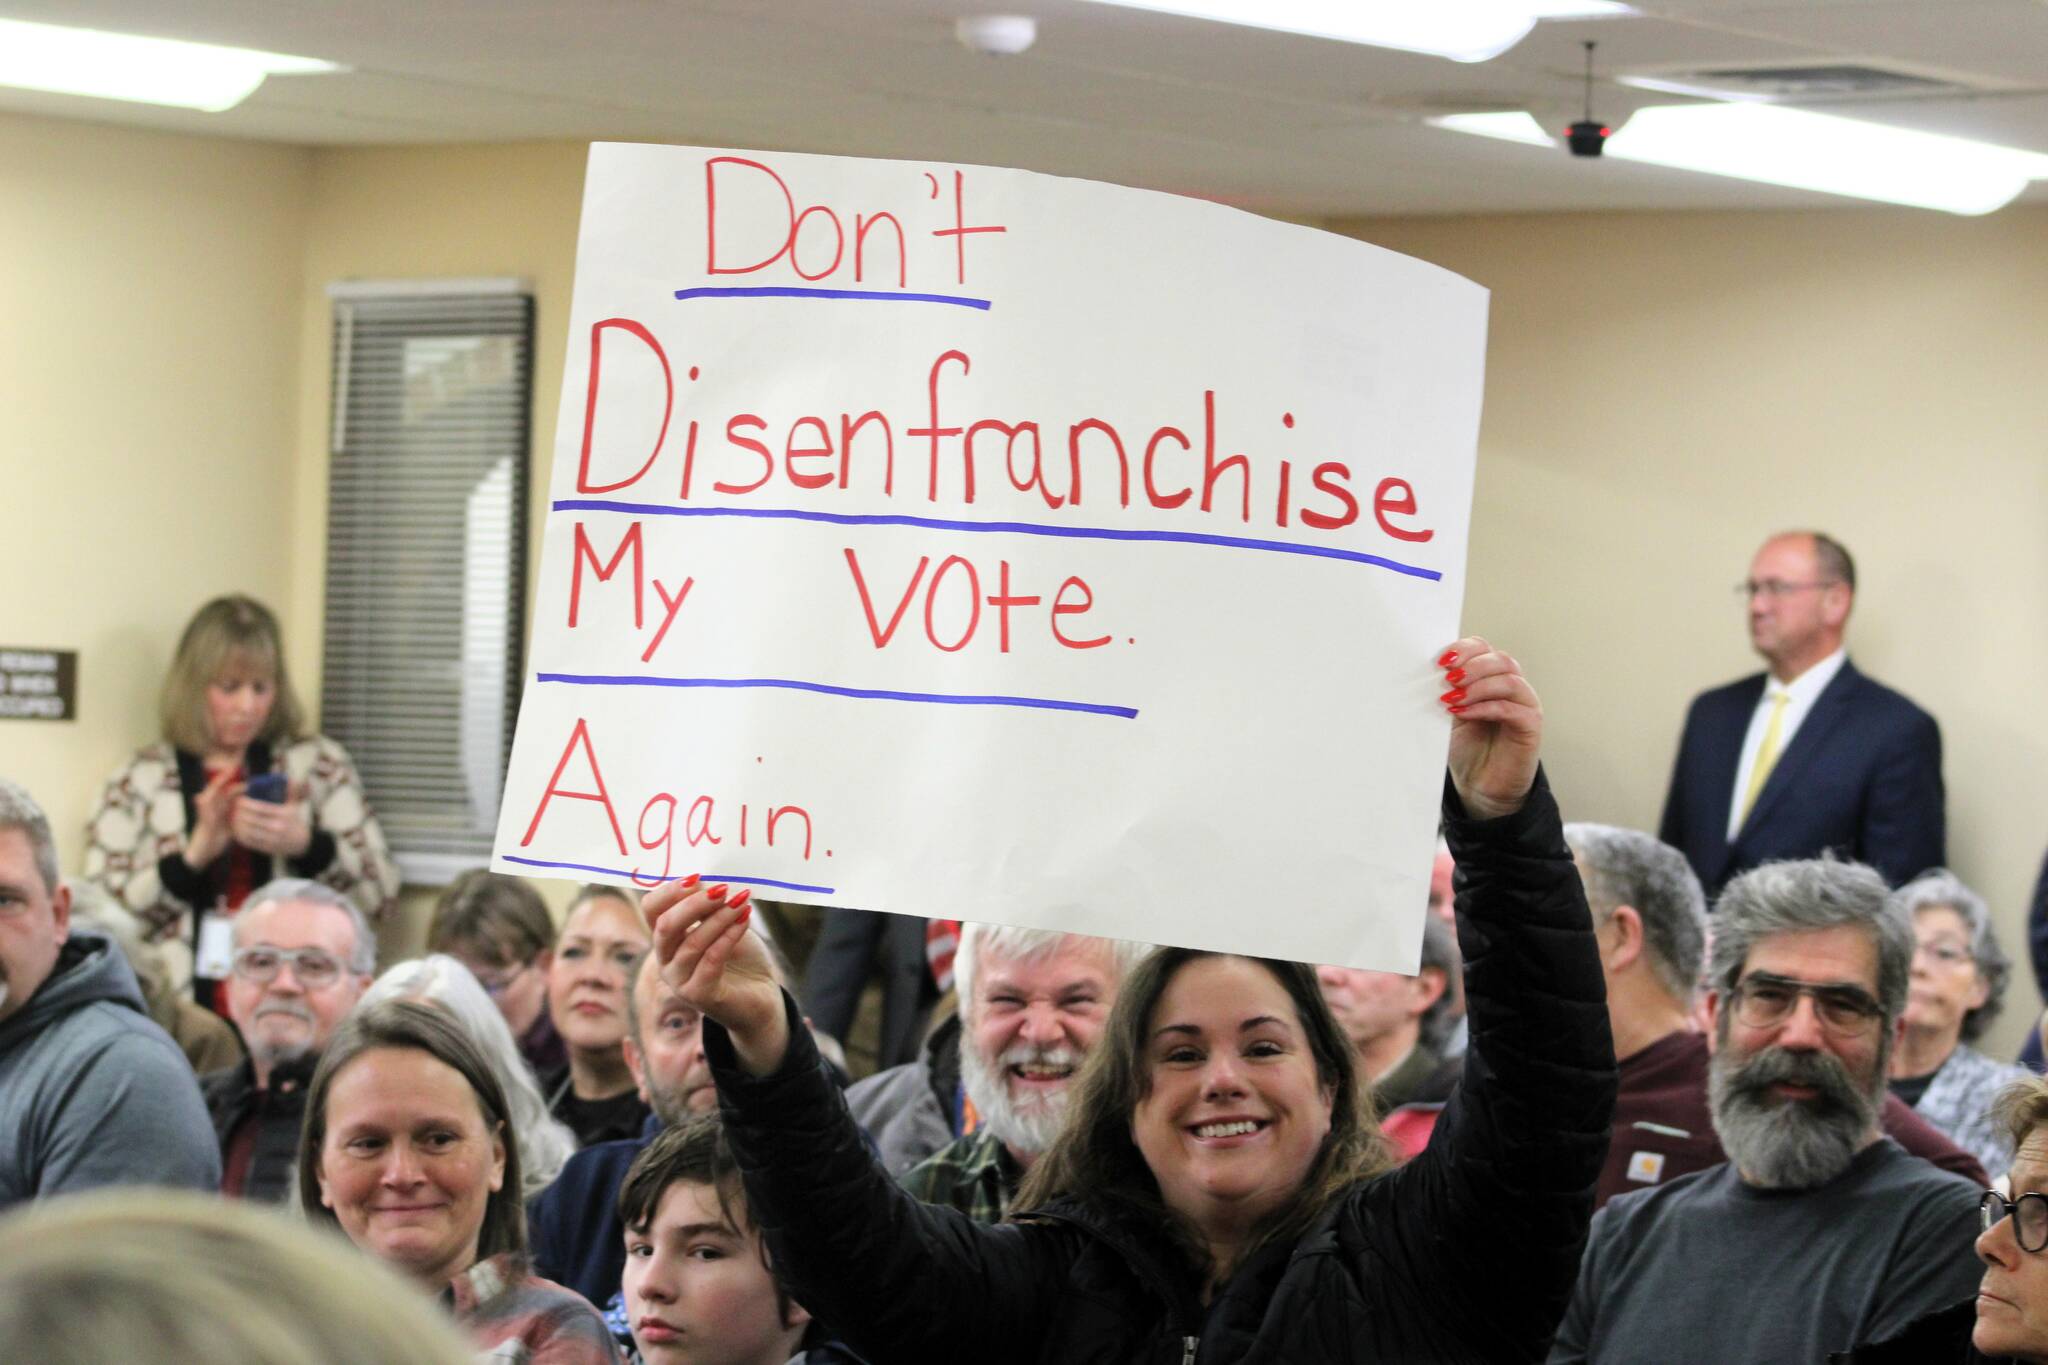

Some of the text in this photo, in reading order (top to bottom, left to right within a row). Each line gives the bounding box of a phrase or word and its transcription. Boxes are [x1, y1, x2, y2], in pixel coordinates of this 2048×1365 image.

[705, 157, 1007, 288] Don't
[577, 318, 1434, 543] Disenfranchise
[568, 522, 694, 661] My
[521, 718, 834, 888] Again.
